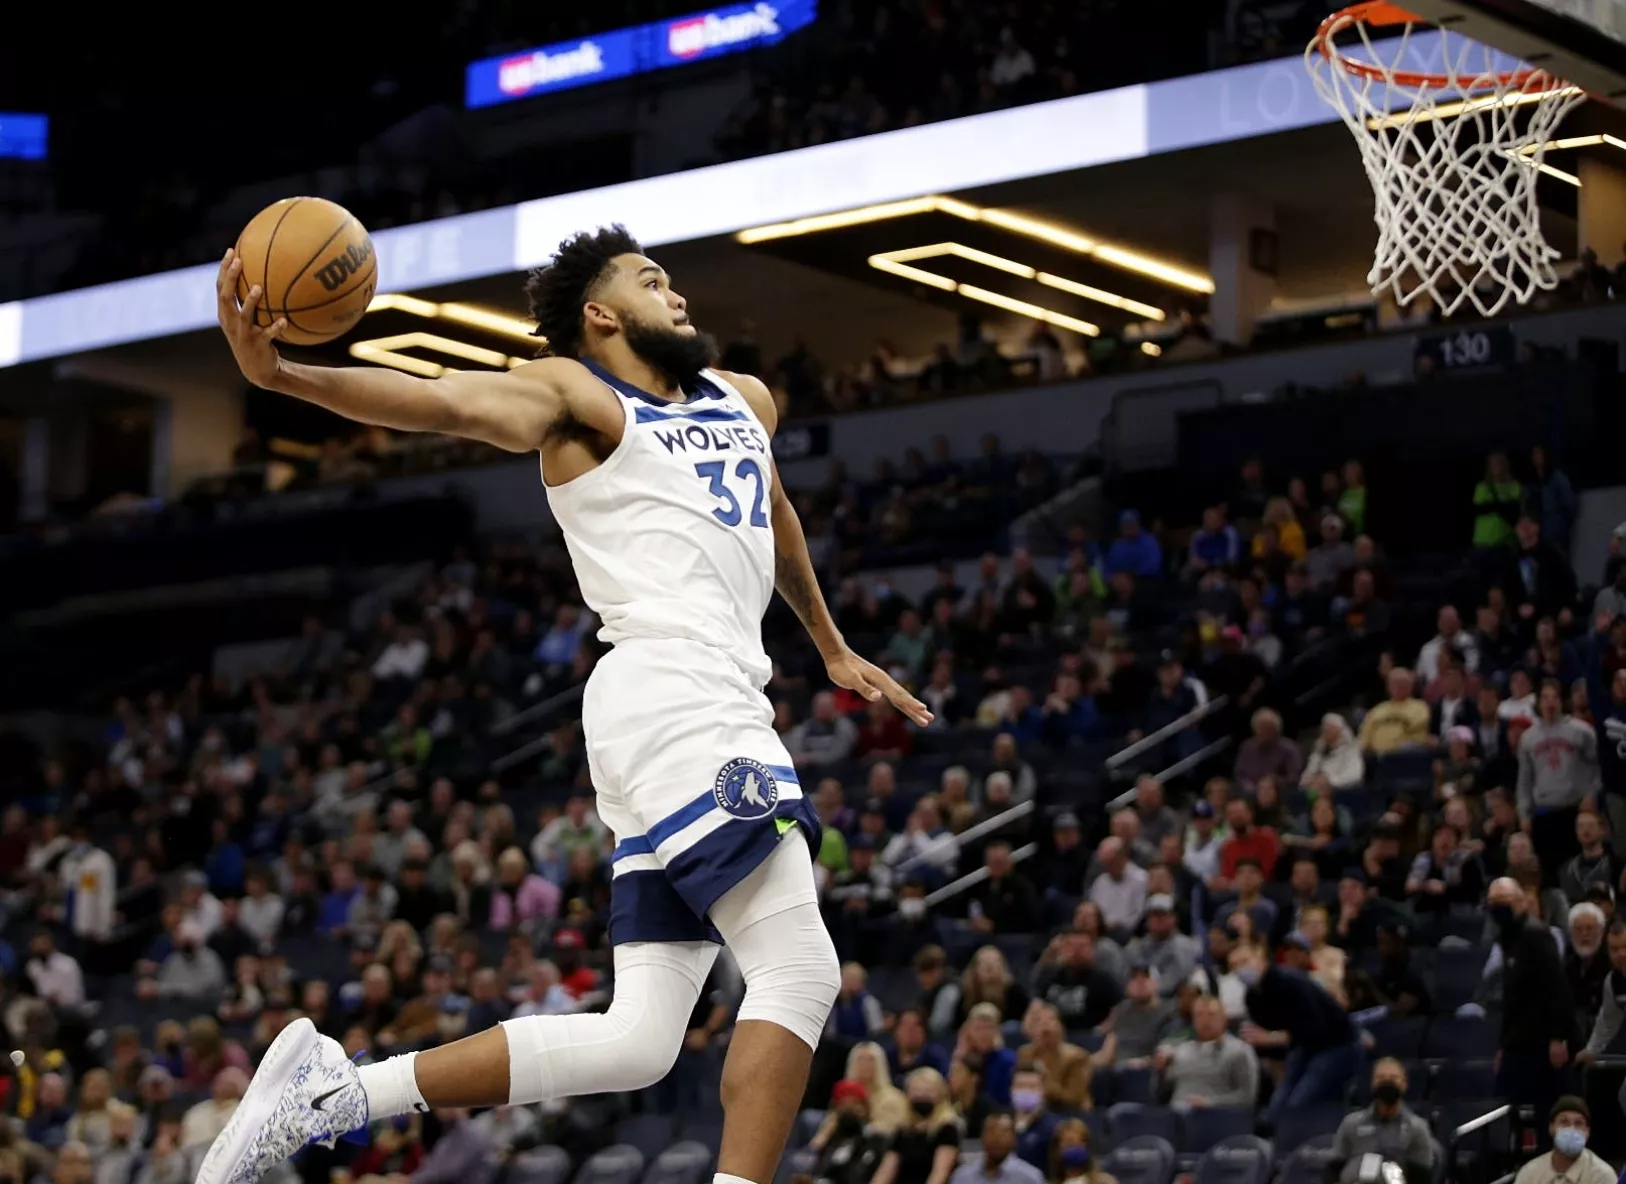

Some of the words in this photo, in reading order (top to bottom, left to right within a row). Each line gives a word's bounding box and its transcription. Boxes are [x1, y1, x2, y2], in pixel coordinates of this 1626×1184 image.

[313, 237, 372, 292] Wilso
[1440, 332, 1491, 366] 130
[653, 425, 765, 454] WOLVES
[694, 458, 769, 529] 32
[716, 763, 735, 807] MINNESOTA
